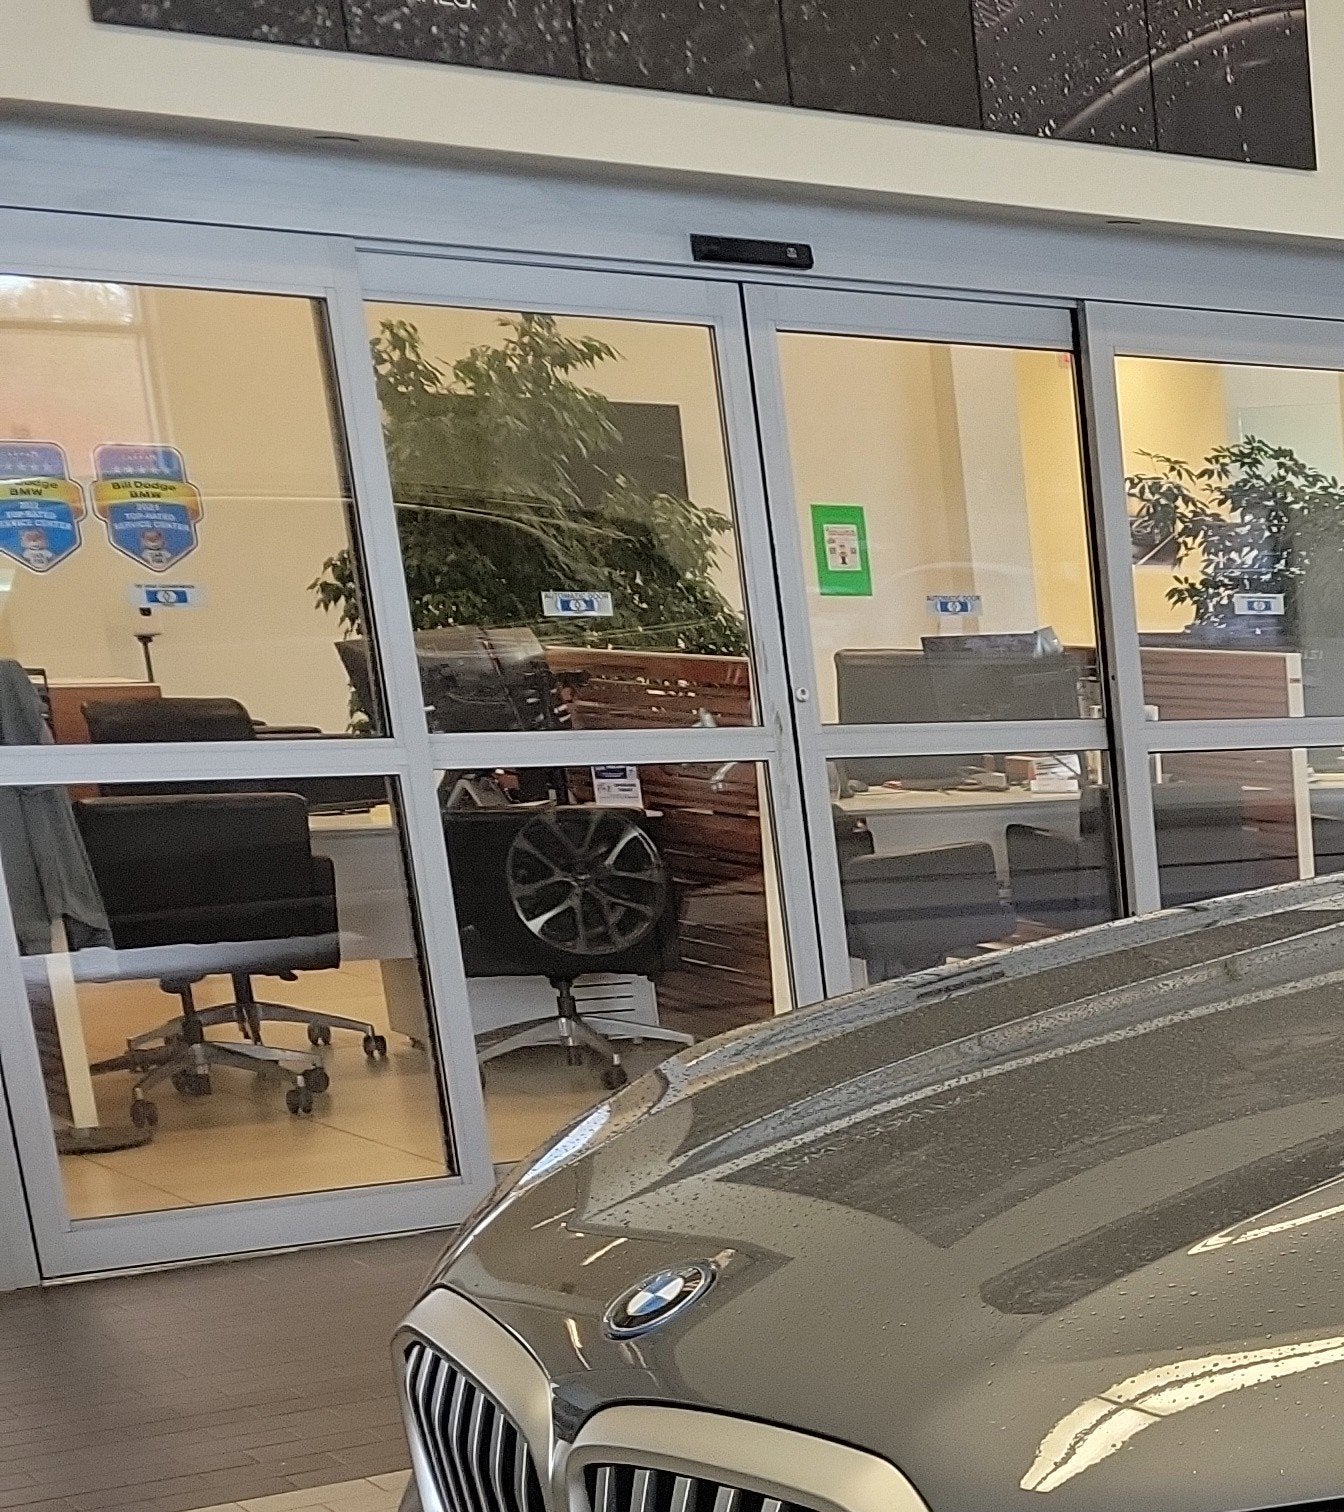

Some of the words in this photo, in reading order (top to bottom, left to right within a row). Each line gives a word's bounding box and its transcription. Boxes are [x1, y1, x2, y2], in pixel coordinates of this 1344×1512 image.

[111, 481, 132, 490] Bill
[134, 480, 176, 491] Dodge
[10, 487, 43, 496] BMW
[130, 490, 161, 499] BMW
